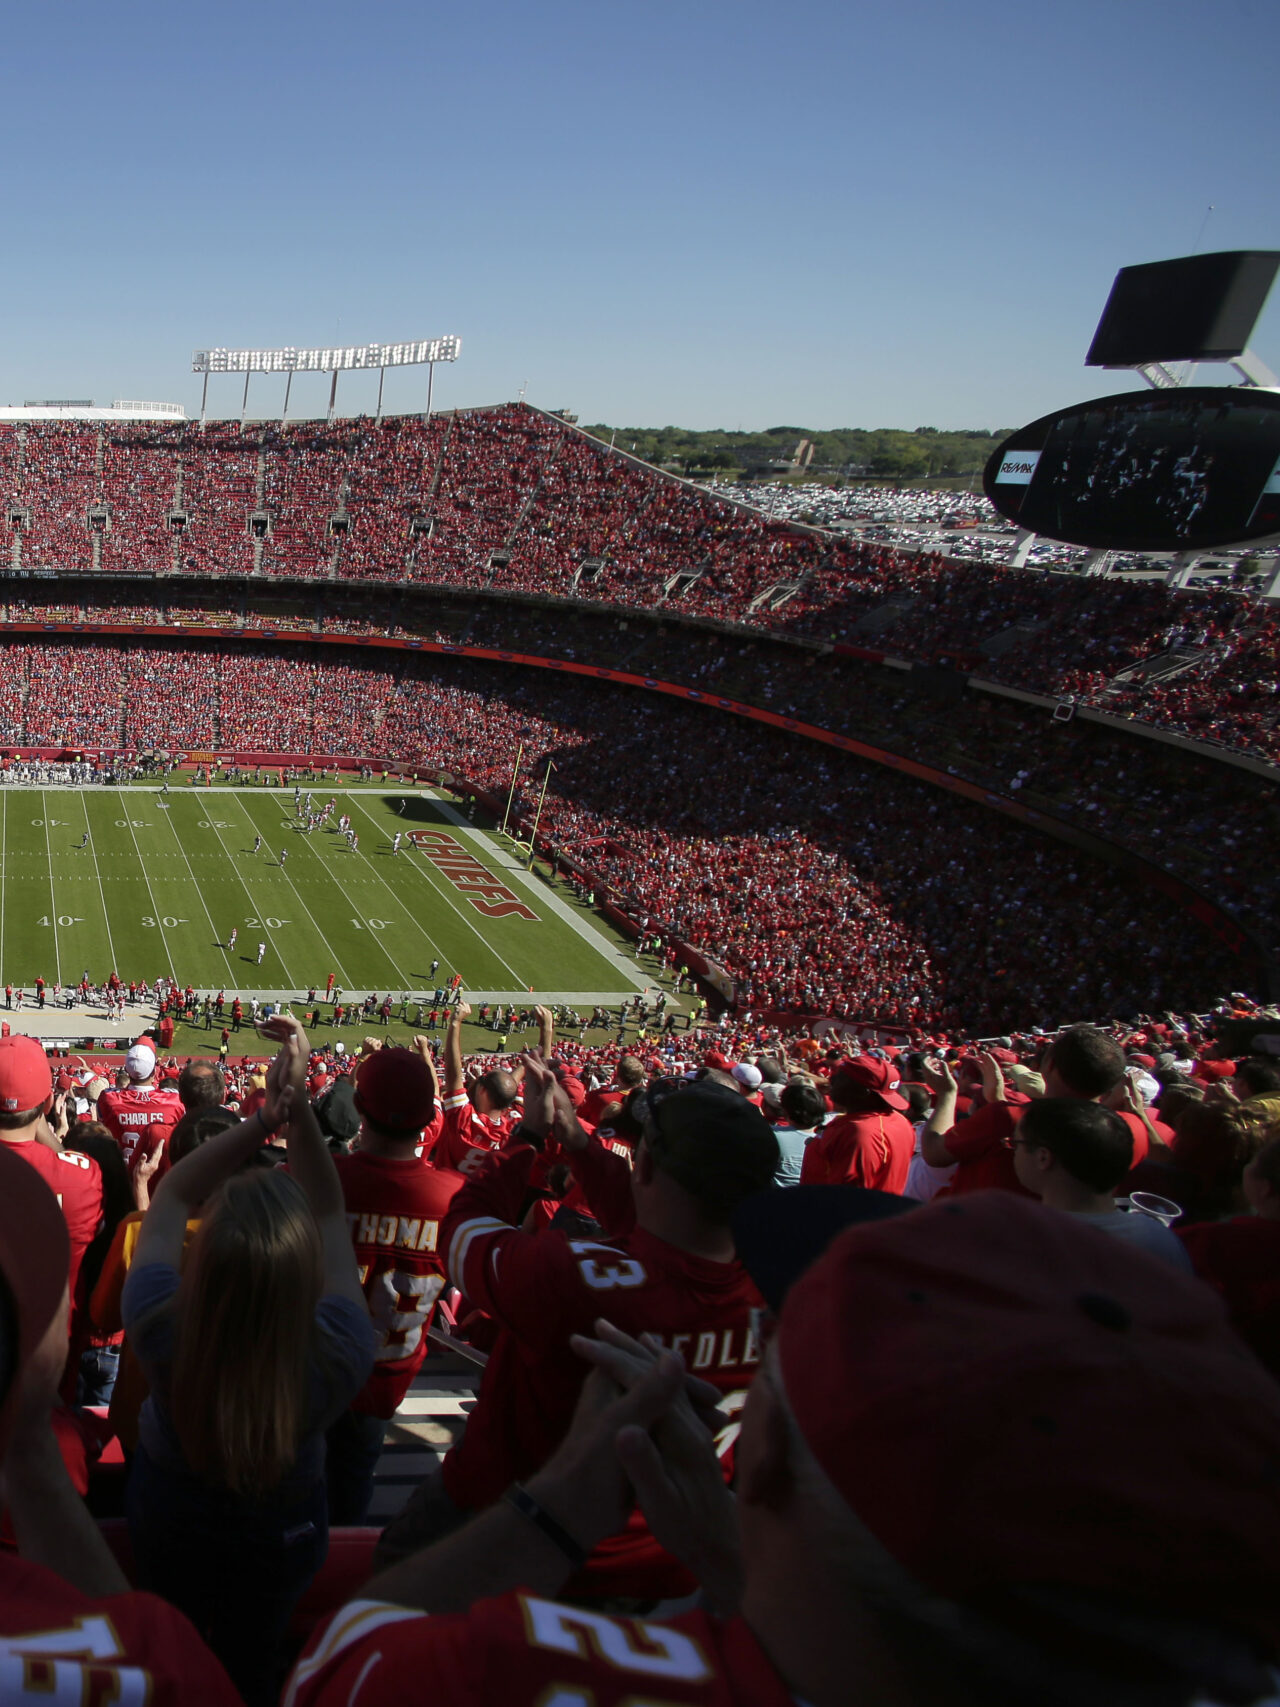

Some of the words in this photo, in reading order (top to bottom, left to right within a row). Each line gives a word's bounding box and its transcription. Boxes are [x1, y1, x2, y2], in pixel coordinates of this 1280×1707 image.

[1001, 461, 1036, 474] RE/MAX
[405, 828, 544, 921] CHIEFS
[36, 914, 74, 927] 40
[141, 916, 179, 928] 30
[243, 917, 283, 929] 20
[349, 917, 386, 930] 10
[119, 1112, 164, 1125] CHARLES
